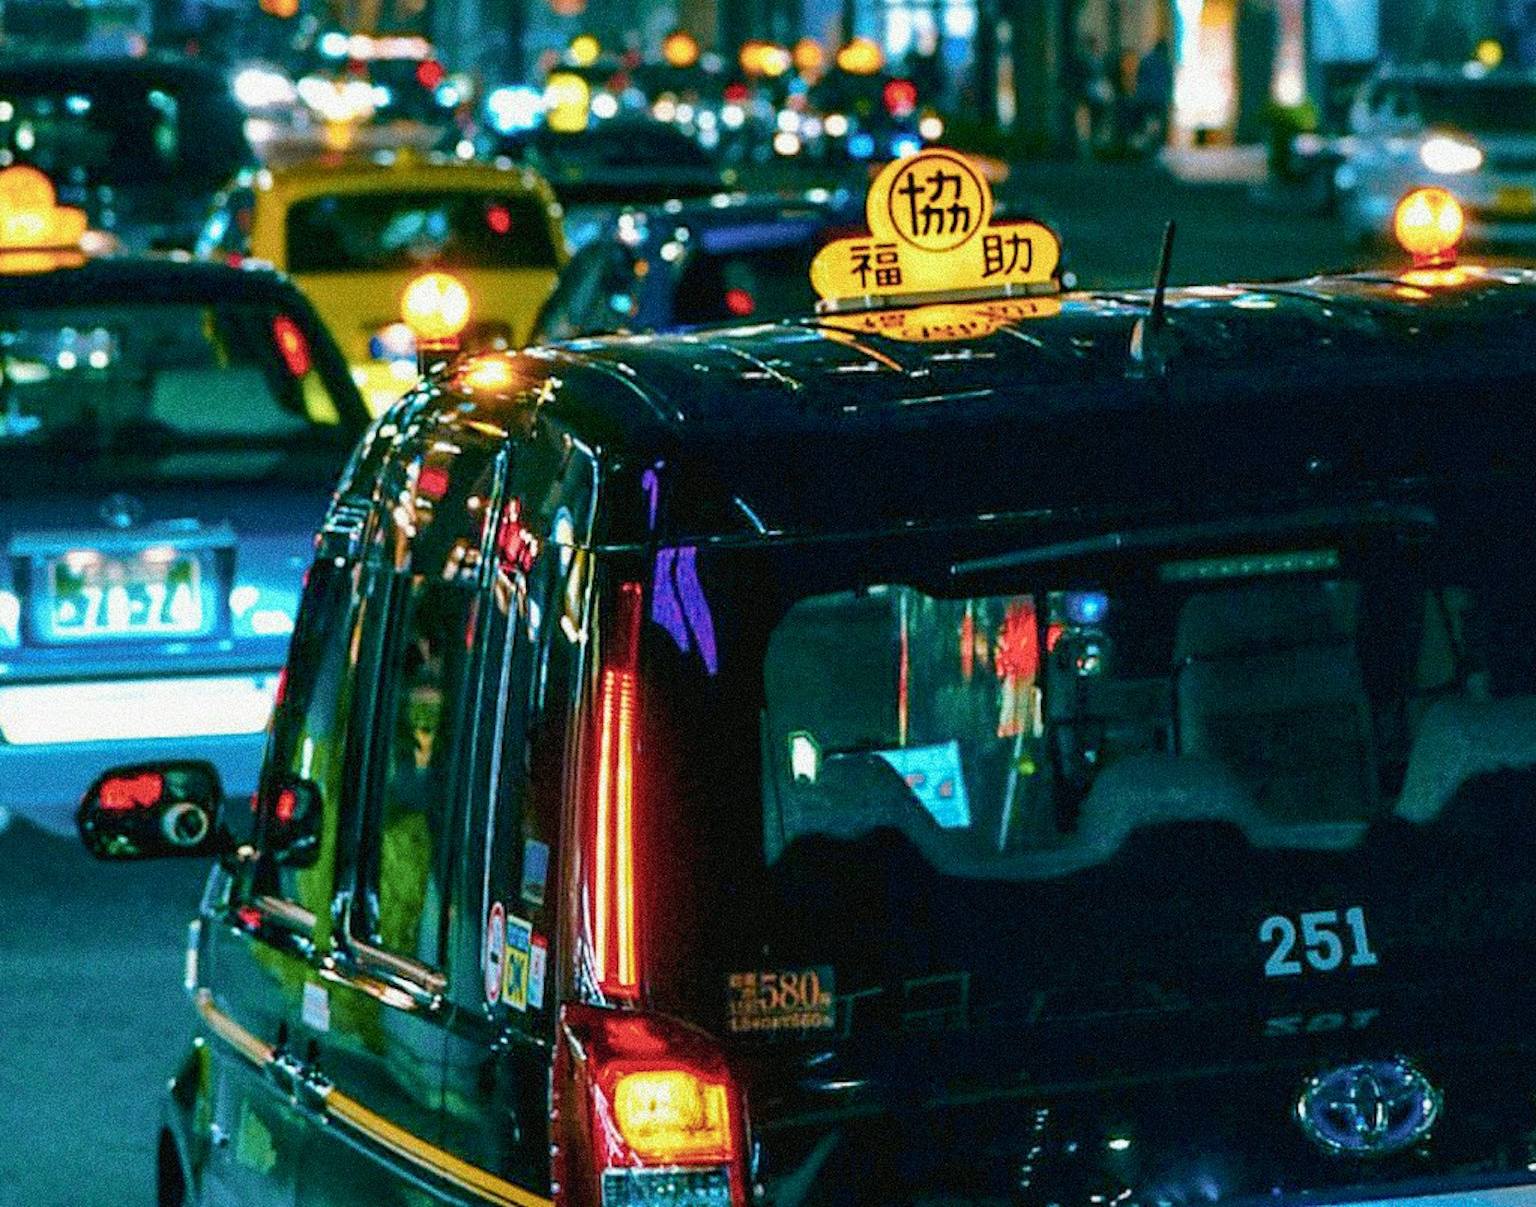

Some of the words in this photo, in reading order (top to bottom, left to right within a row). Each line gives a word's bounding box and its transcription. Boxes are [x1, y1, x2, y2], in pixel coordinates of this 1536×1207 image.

[898, 170, 970, 236] 協
[850, 243, 902, 289] 福
[981, 233, 1033, 279] 助
[1259, 907, 1378, 977] 251
